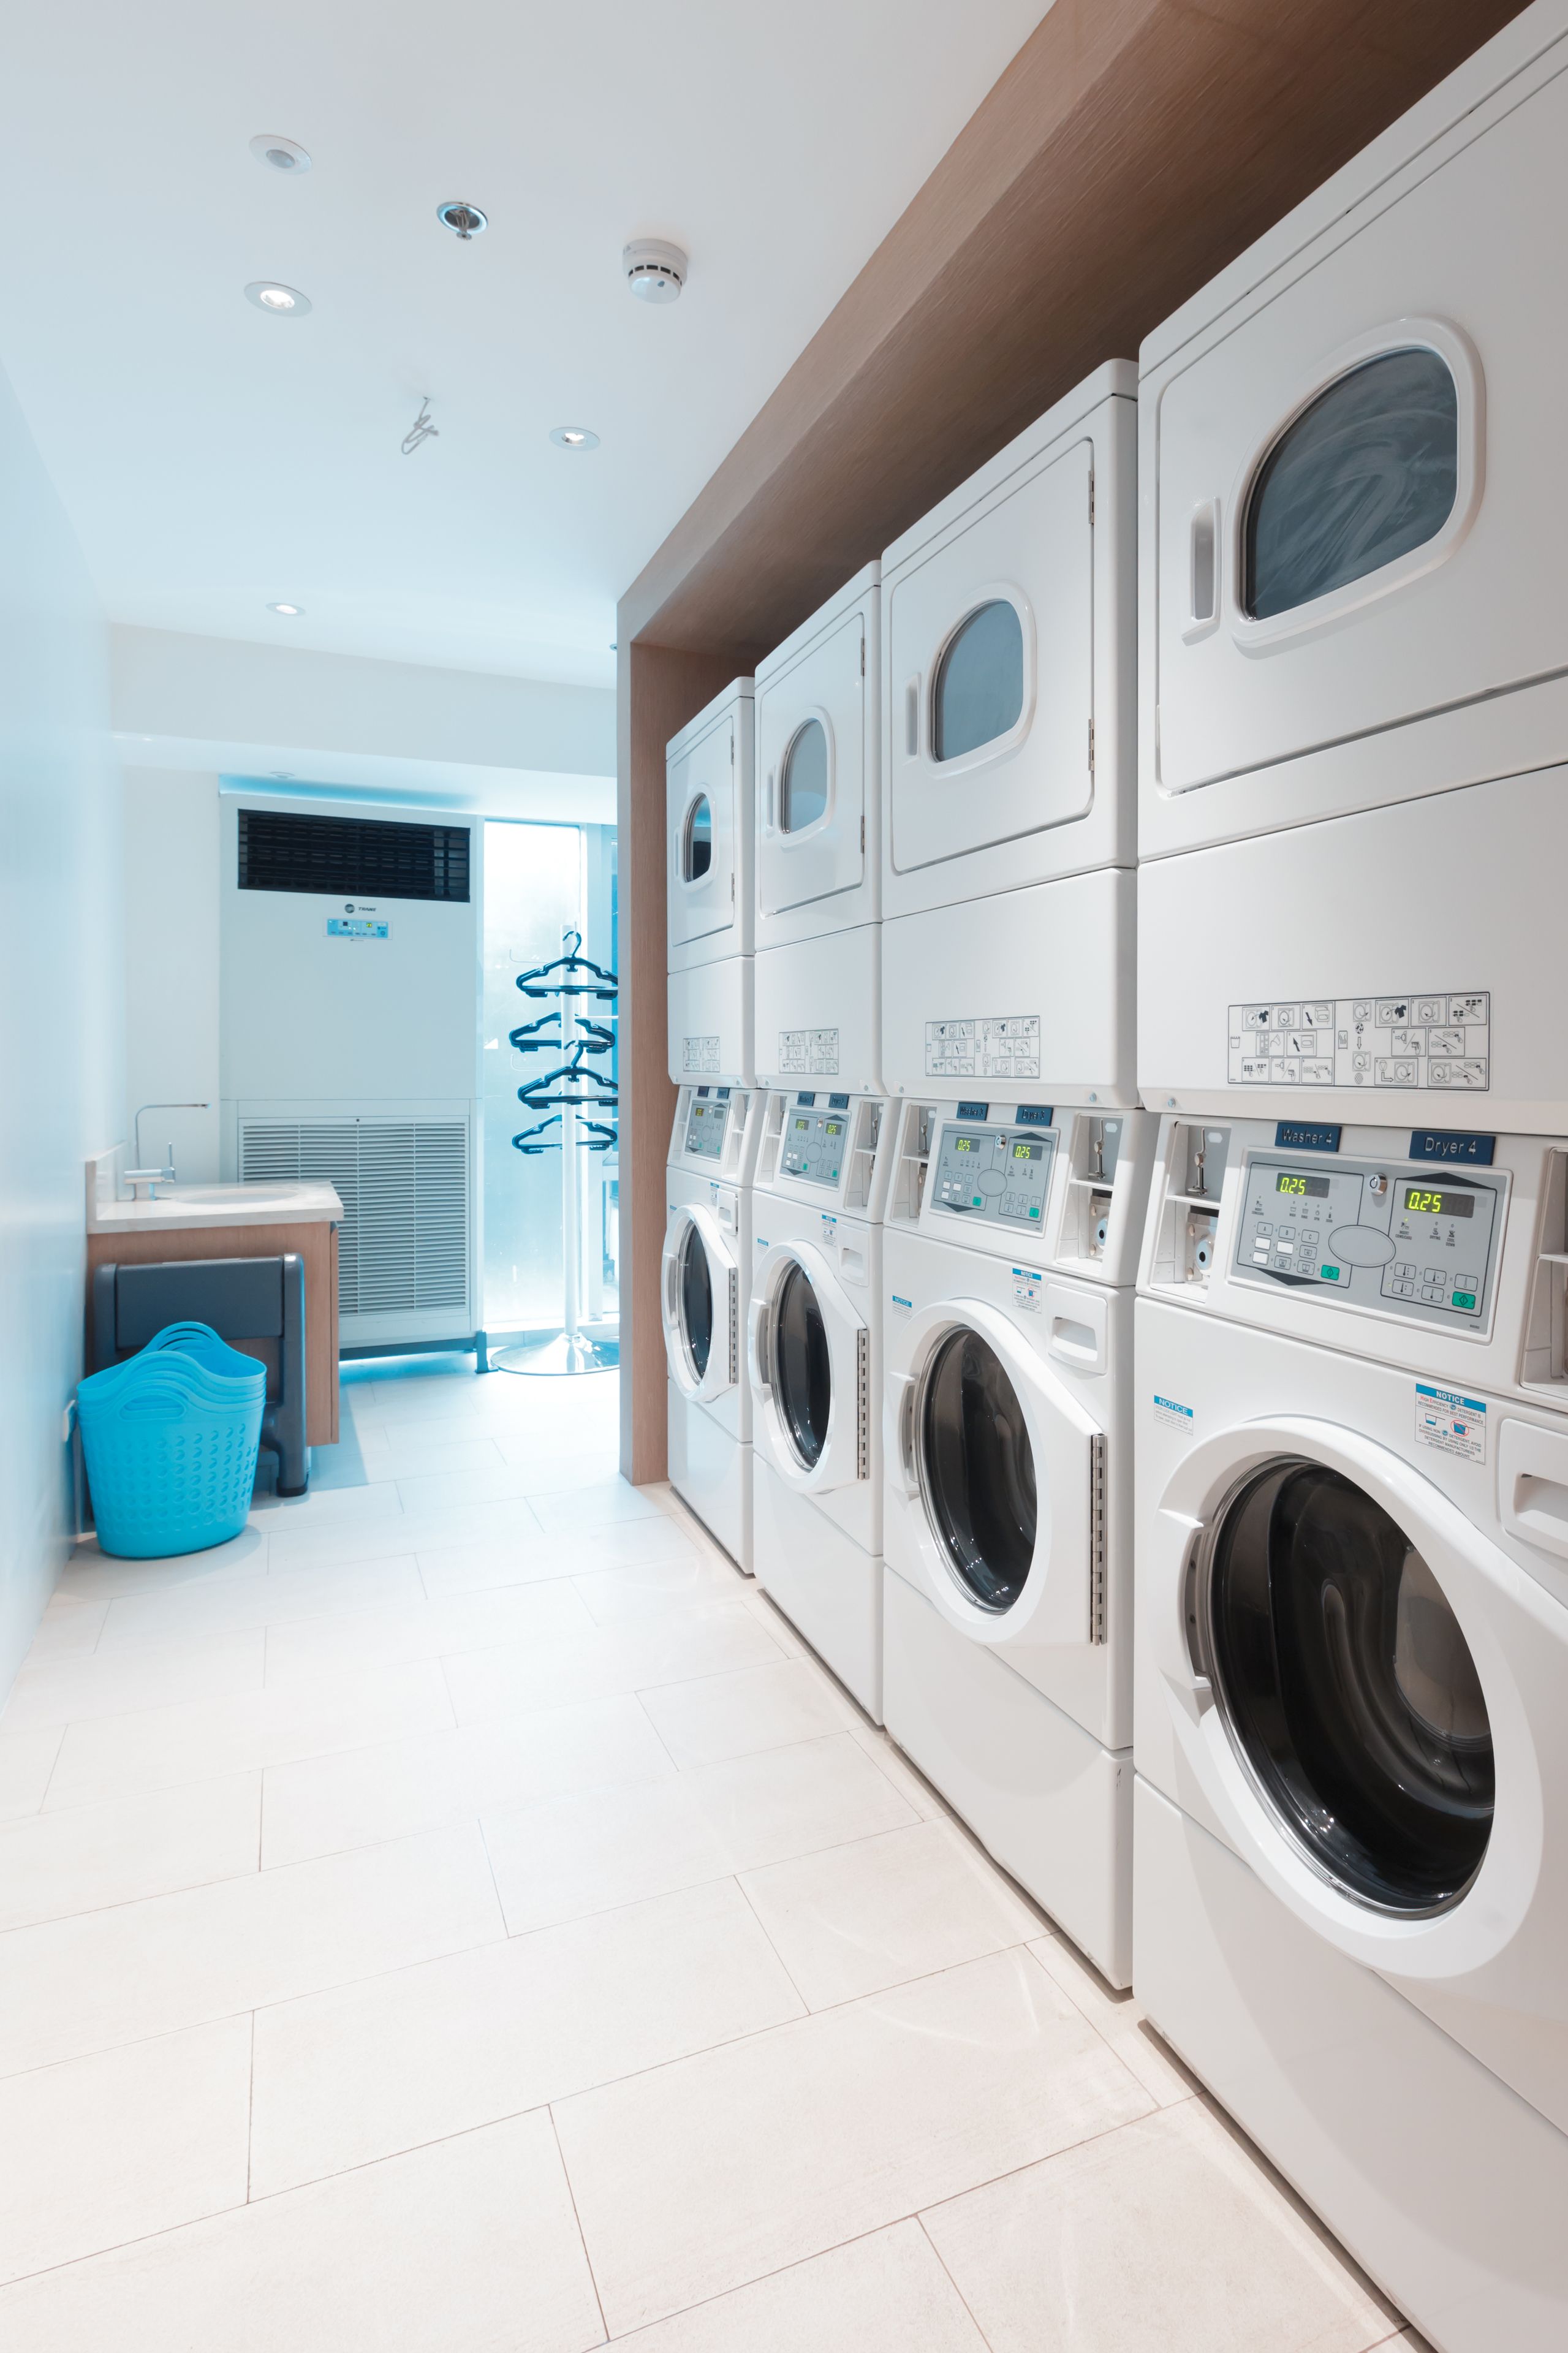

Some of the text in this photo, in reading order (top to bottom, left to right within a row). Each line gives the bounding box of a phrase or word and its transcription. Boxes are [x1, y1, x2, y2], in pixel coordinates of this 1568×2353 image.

[1022, 1109, 1045, 1122] Dryer 3
[1282, 1128, 1332, 1144] Washer 4
[1015, 1146, 1031, 1159] 0.25
[1425, 1137, 1477, 1156] Dryer 4
[1280, 1177, 1306, 1195] 0.25
[1409, 1192, 1442, 1212] 0.25
[1436, 1390, 1465, 1405] NOTICE
[1159, 1398, 1189, 1415] NOTICE
[1418, 1401, 1442, 1412] RECOMMENDED
[1459, 1413, 1484, 1425] PERFORMANCE
[1458, 1408, 1477, 1417] DETERGENT
